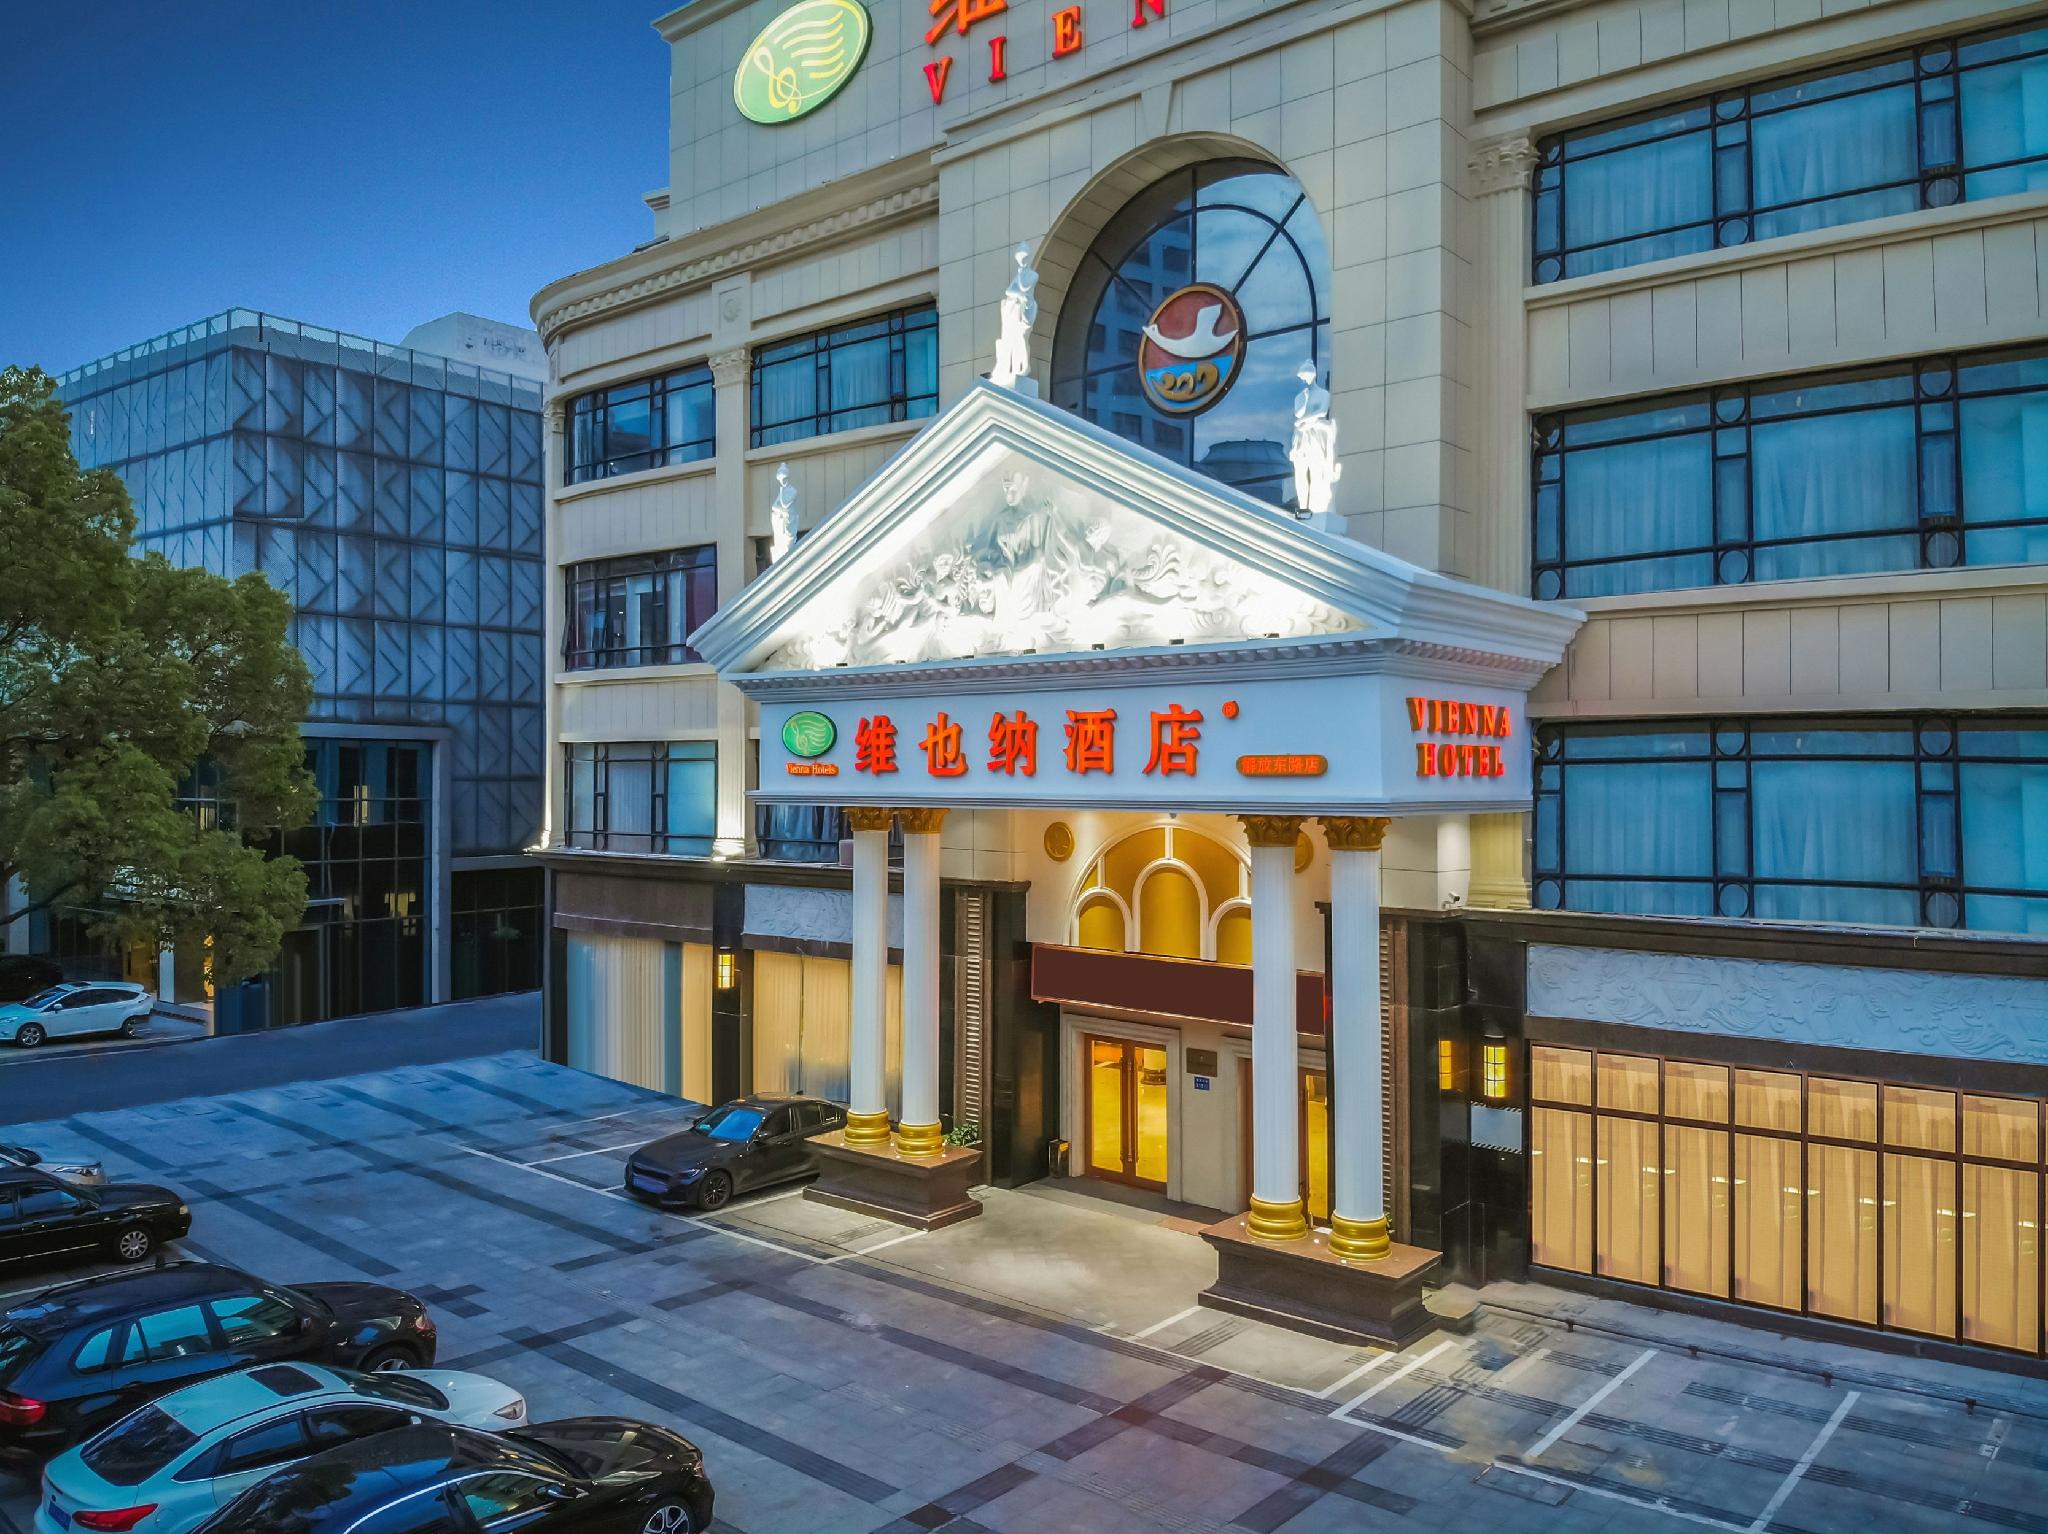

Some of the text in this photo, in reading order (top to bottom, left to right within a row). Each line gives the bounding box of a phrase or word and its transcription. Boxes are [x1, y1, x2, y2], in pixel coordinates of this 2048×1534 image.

[1406, 697, 1511, 737] VIENNA
[855, 703, 1204, 776] 维也纳酒店
[1416, 743, 1505, 777] HOTEL
